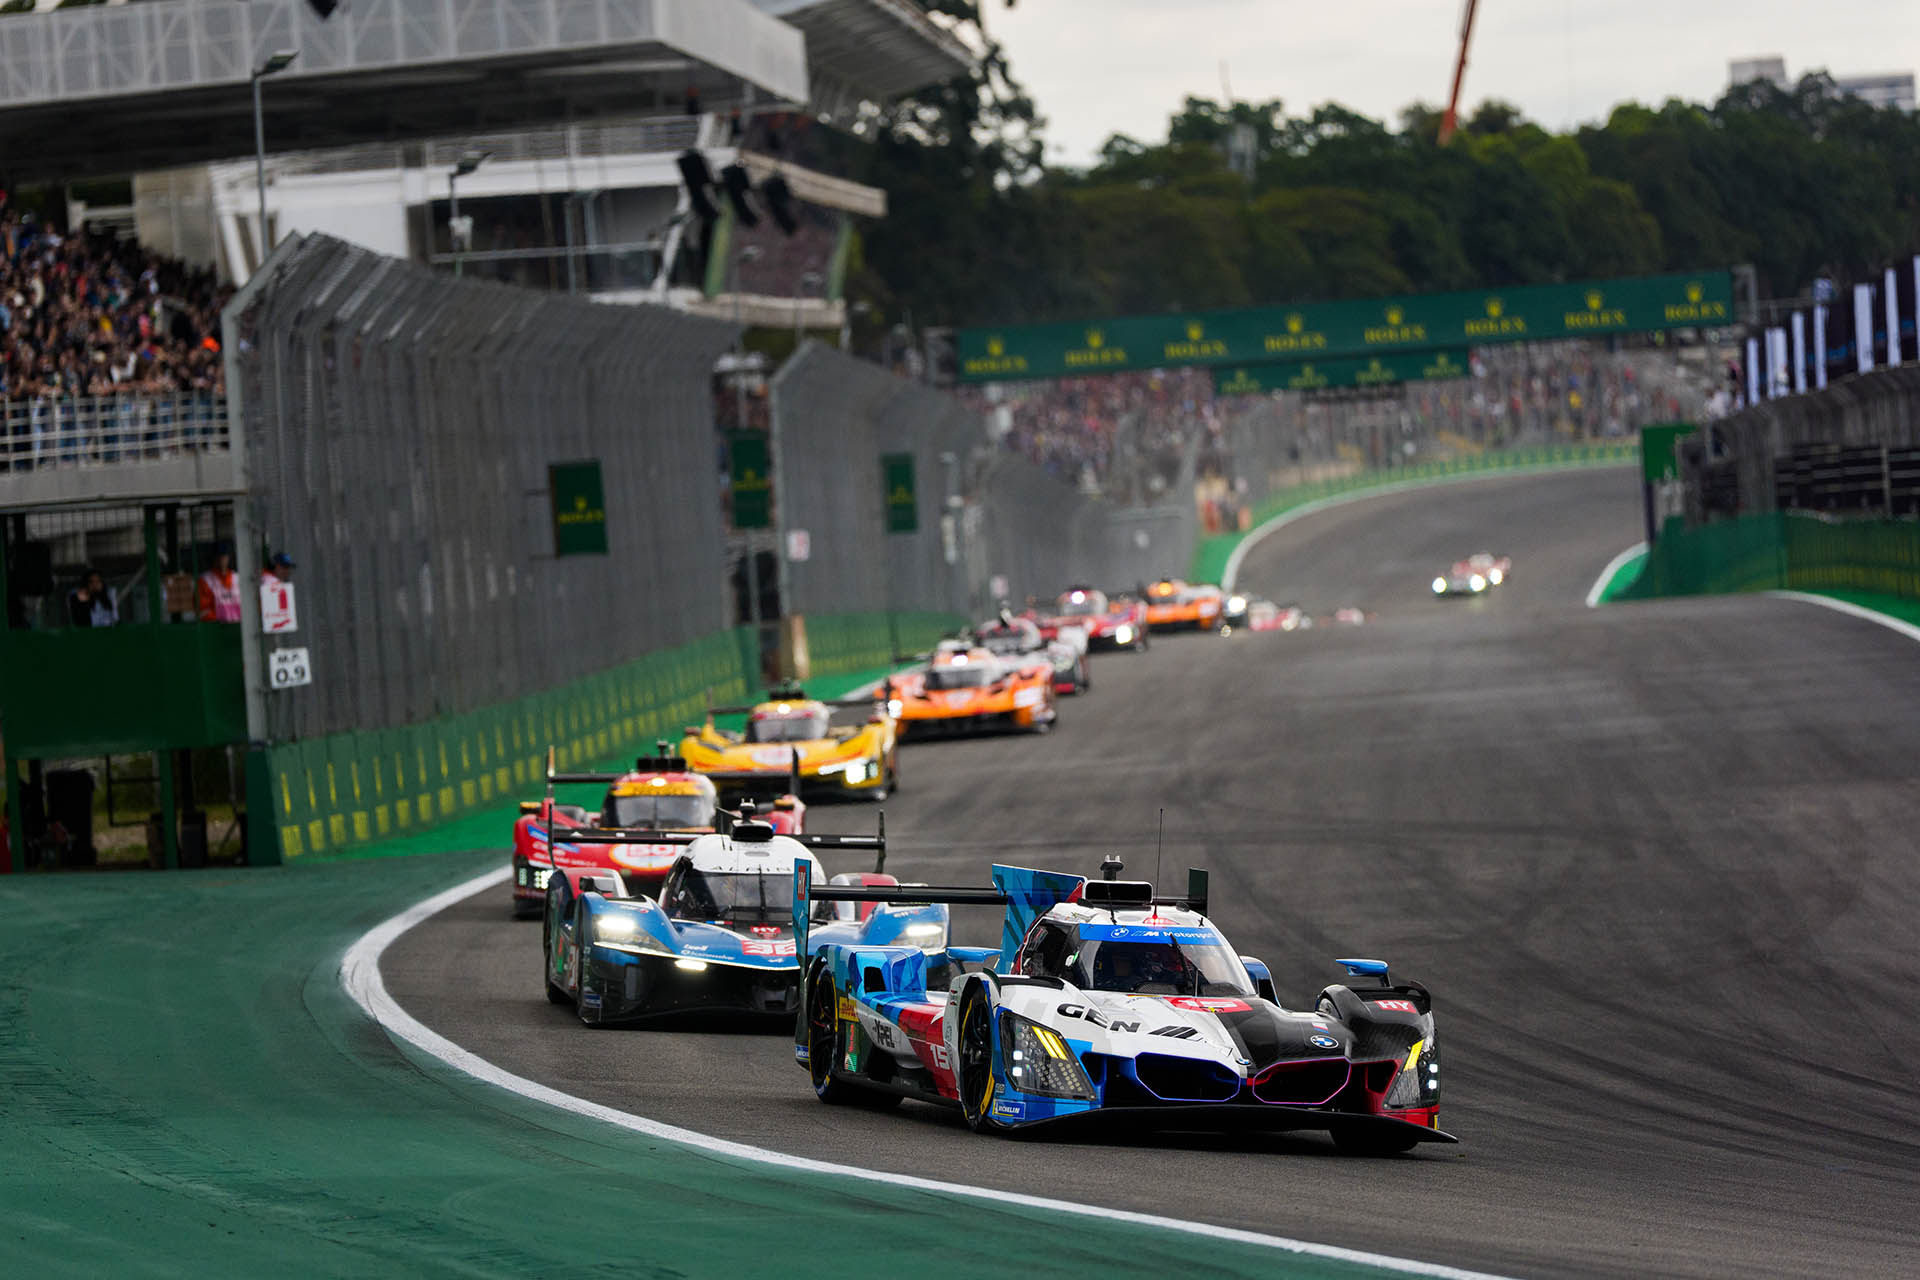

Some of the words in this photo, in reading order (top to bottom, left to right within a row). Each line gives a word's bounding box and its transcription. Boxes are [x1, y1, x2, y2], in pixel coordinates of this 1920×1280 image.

[1565, 308, 1625, 329] ROLEX
[1665, 301, 1725, 322] ROLEX
[1365, 323, 1426, 345] ROLEX
[1465, 316, 1527, 337] ROLEX
[275, 664, 306, 684] 0.9
[1377, 1000, 1409, 1010] HY
[1056, 1002, 1142, 1034] GEN
[930, 1043, 951, 1070] 15
